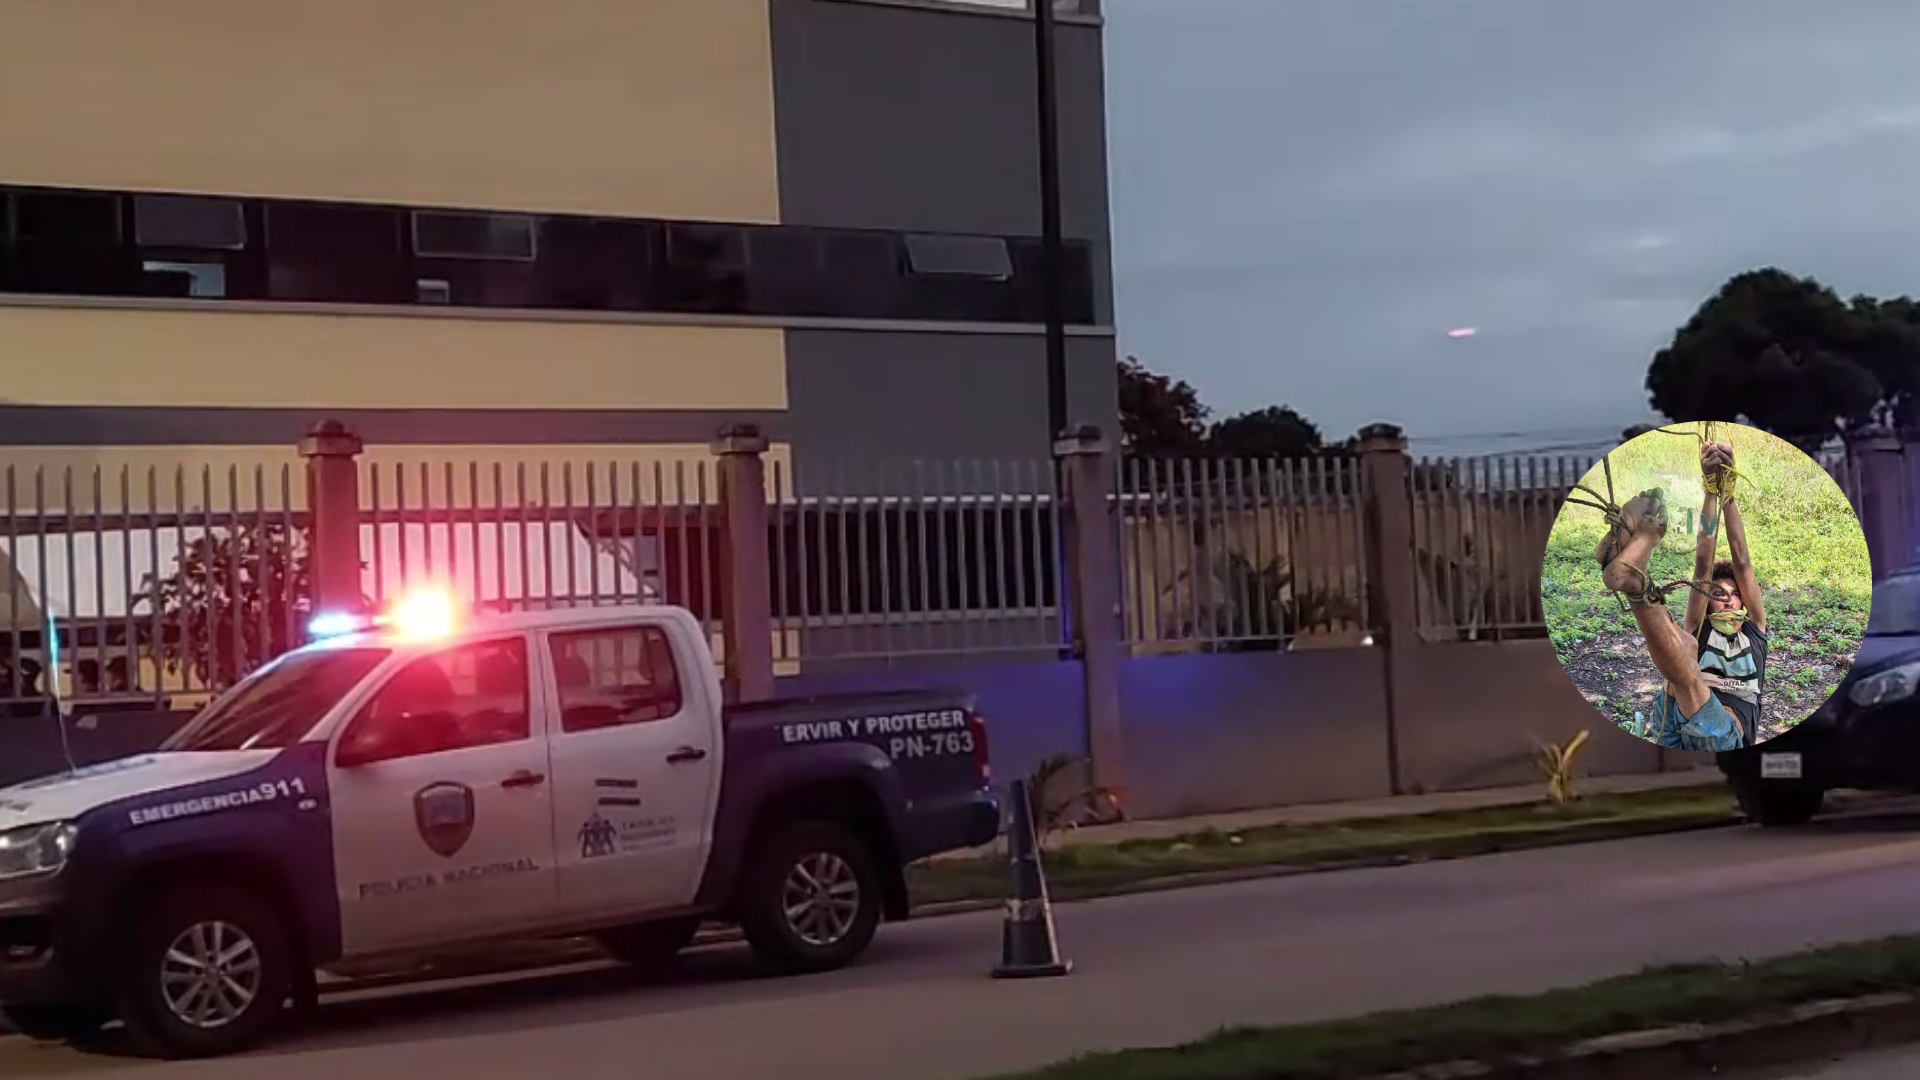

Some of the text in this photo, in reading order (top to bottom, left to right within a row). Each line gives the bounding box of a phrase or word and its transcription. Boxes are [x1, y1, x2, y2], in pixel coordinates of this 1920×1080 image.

[776, 710, 965, 743] ERVIR Y PROTEGER
[890, 731, 974, 759] PN-763
[442, 857, 540, 883] NACIONAL
